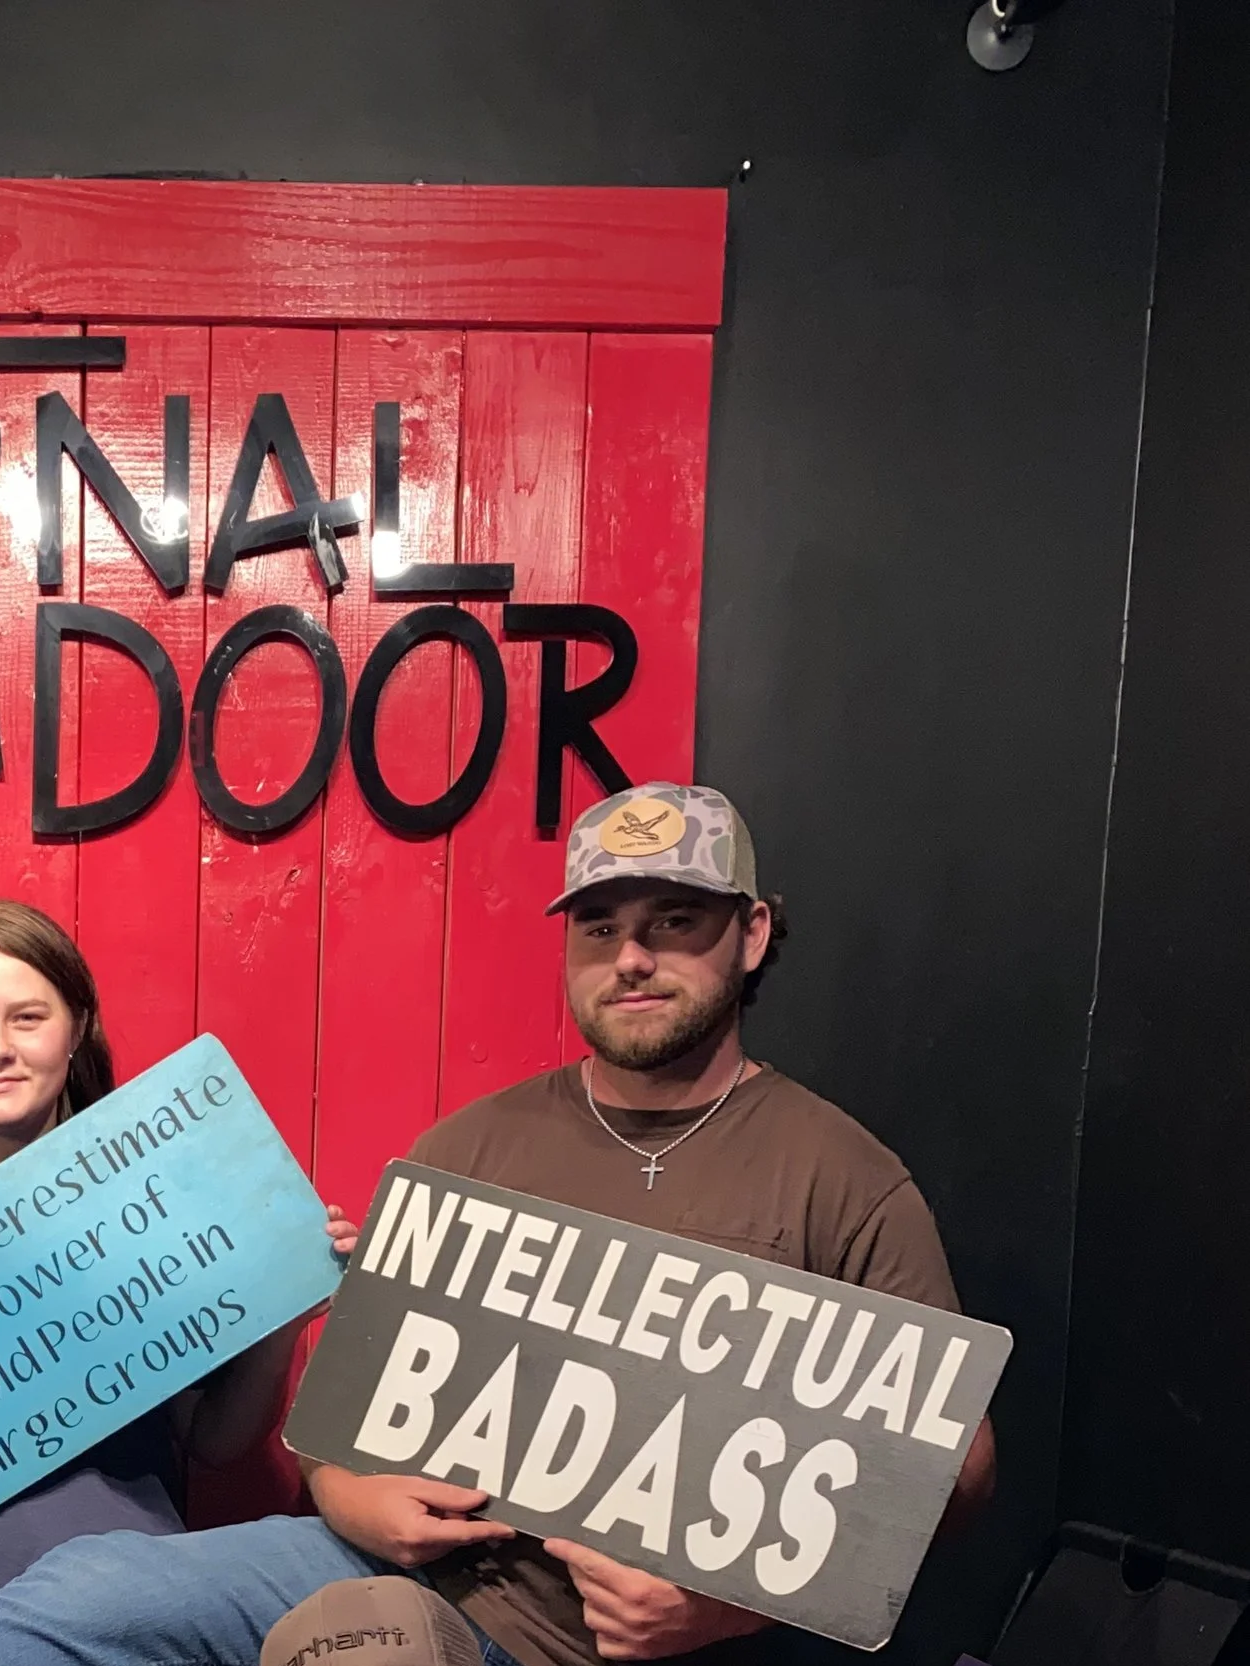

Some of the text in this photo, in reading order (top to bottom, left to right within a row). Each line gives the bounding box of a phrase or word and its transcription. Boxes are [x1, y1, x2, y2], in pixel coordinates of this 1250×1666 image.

[32, 602, 639, 840] DOOR
[37, 1252, 187, 1364] People
[189, 1222, 236, 1272] in
[121, 1174, 170, 1235] of
[85, 1289, 247, 1407] Groups
[360, 1176, 971, 1450] INTELLECTUAL
[354, 1311, 858, 1595] BADASS
